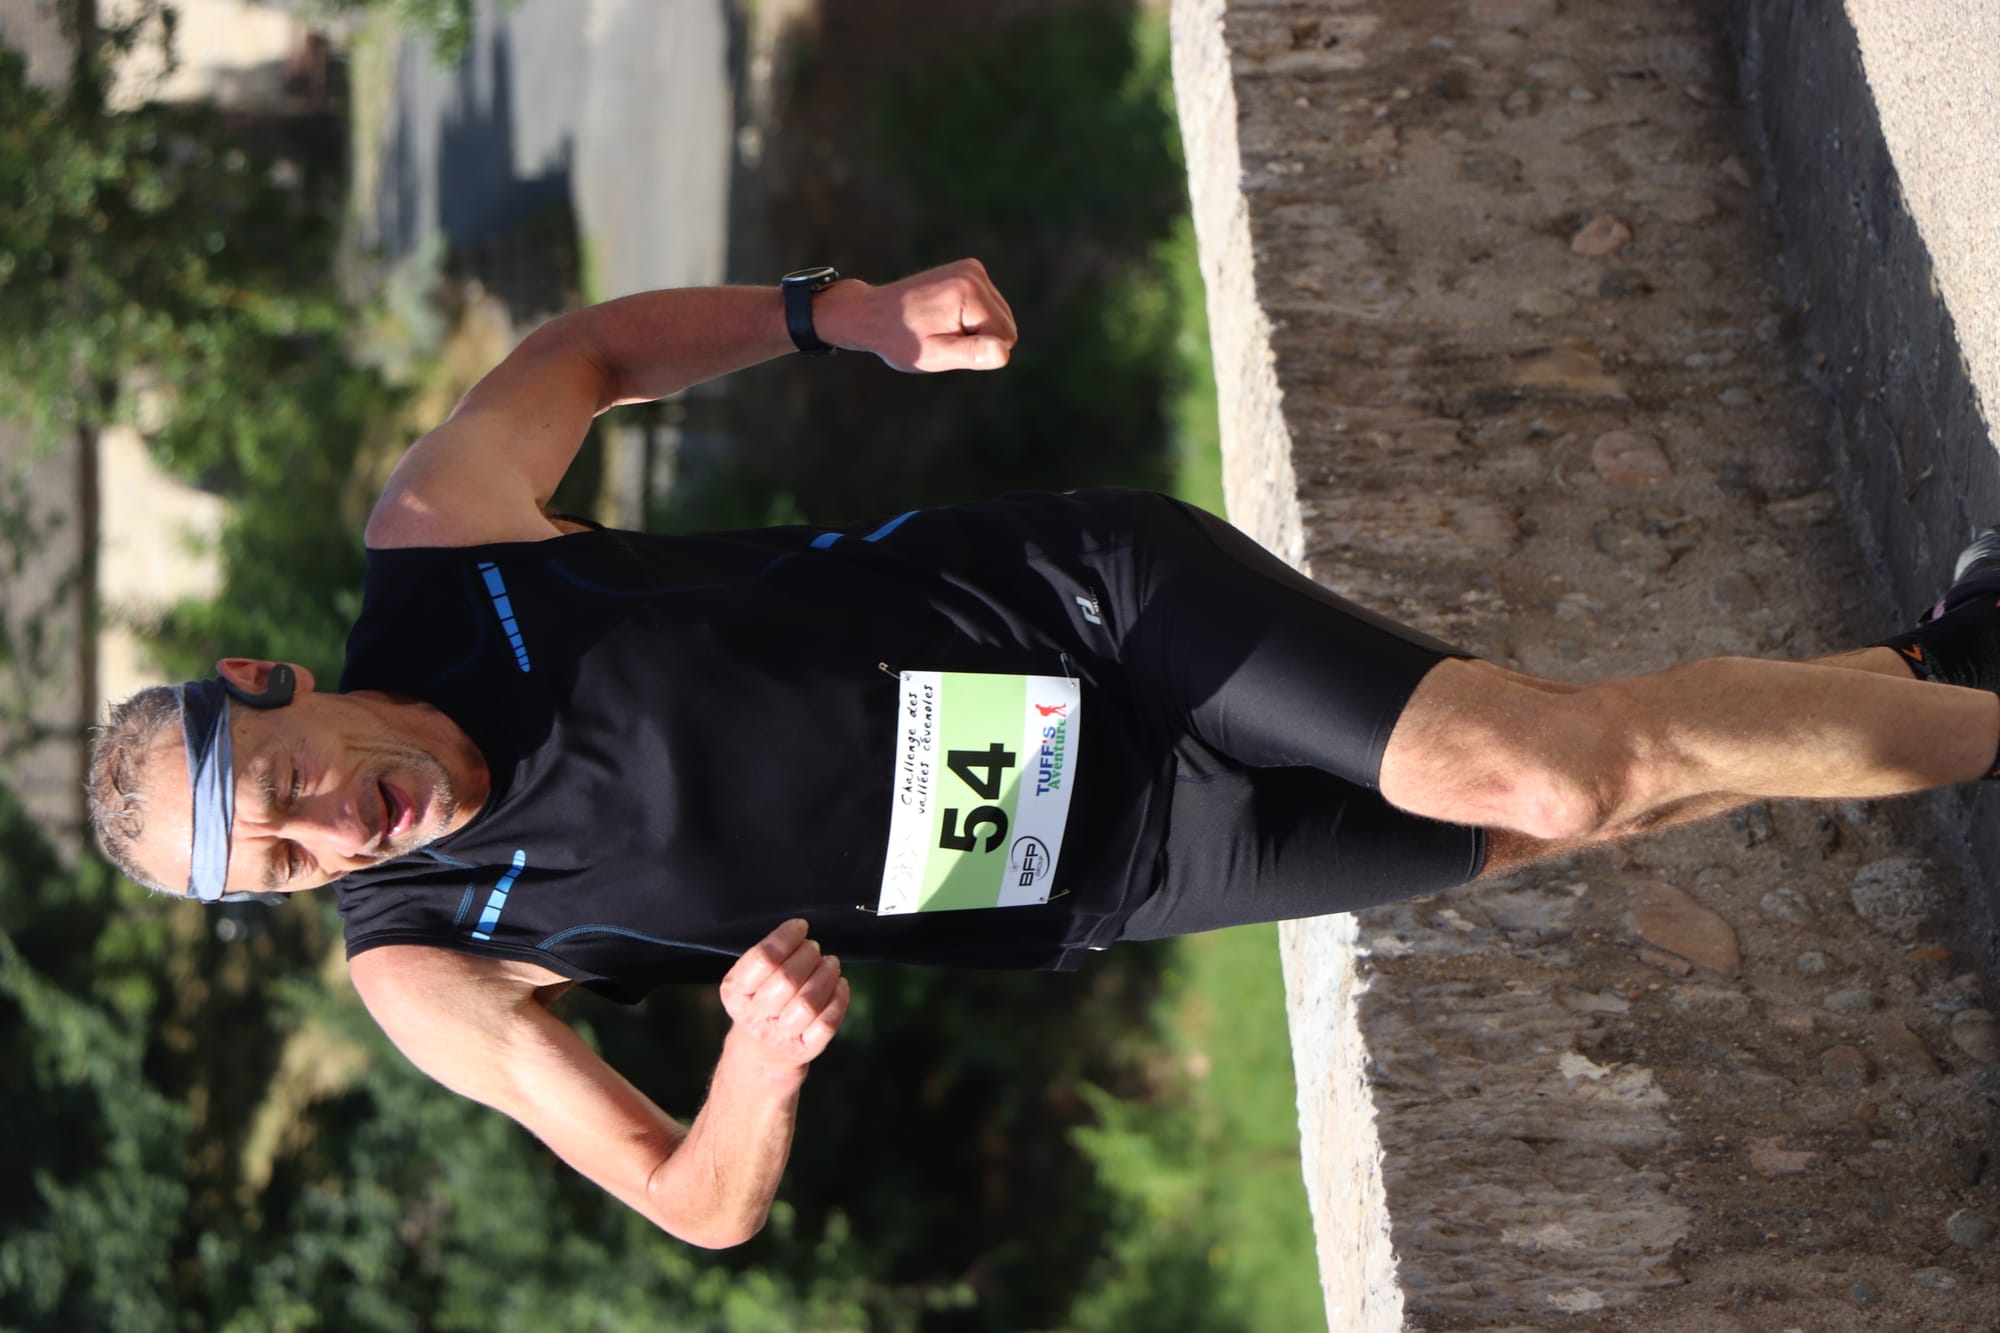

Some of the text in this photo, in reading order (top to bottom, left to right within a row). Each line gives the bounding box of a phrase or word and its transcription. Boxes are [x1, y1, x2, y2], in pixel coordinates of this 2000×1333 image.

[901, 692, 920, 805] Challenge des
[917, 684, 933, 814] vallées cévenoles
[1036, 726, 1056, 796] TUFF'S
[1047, 718, 1066, 790] Aventure
[939, 743, 1016, 853] 54
[1019, 843, 1039, 886] BFP
